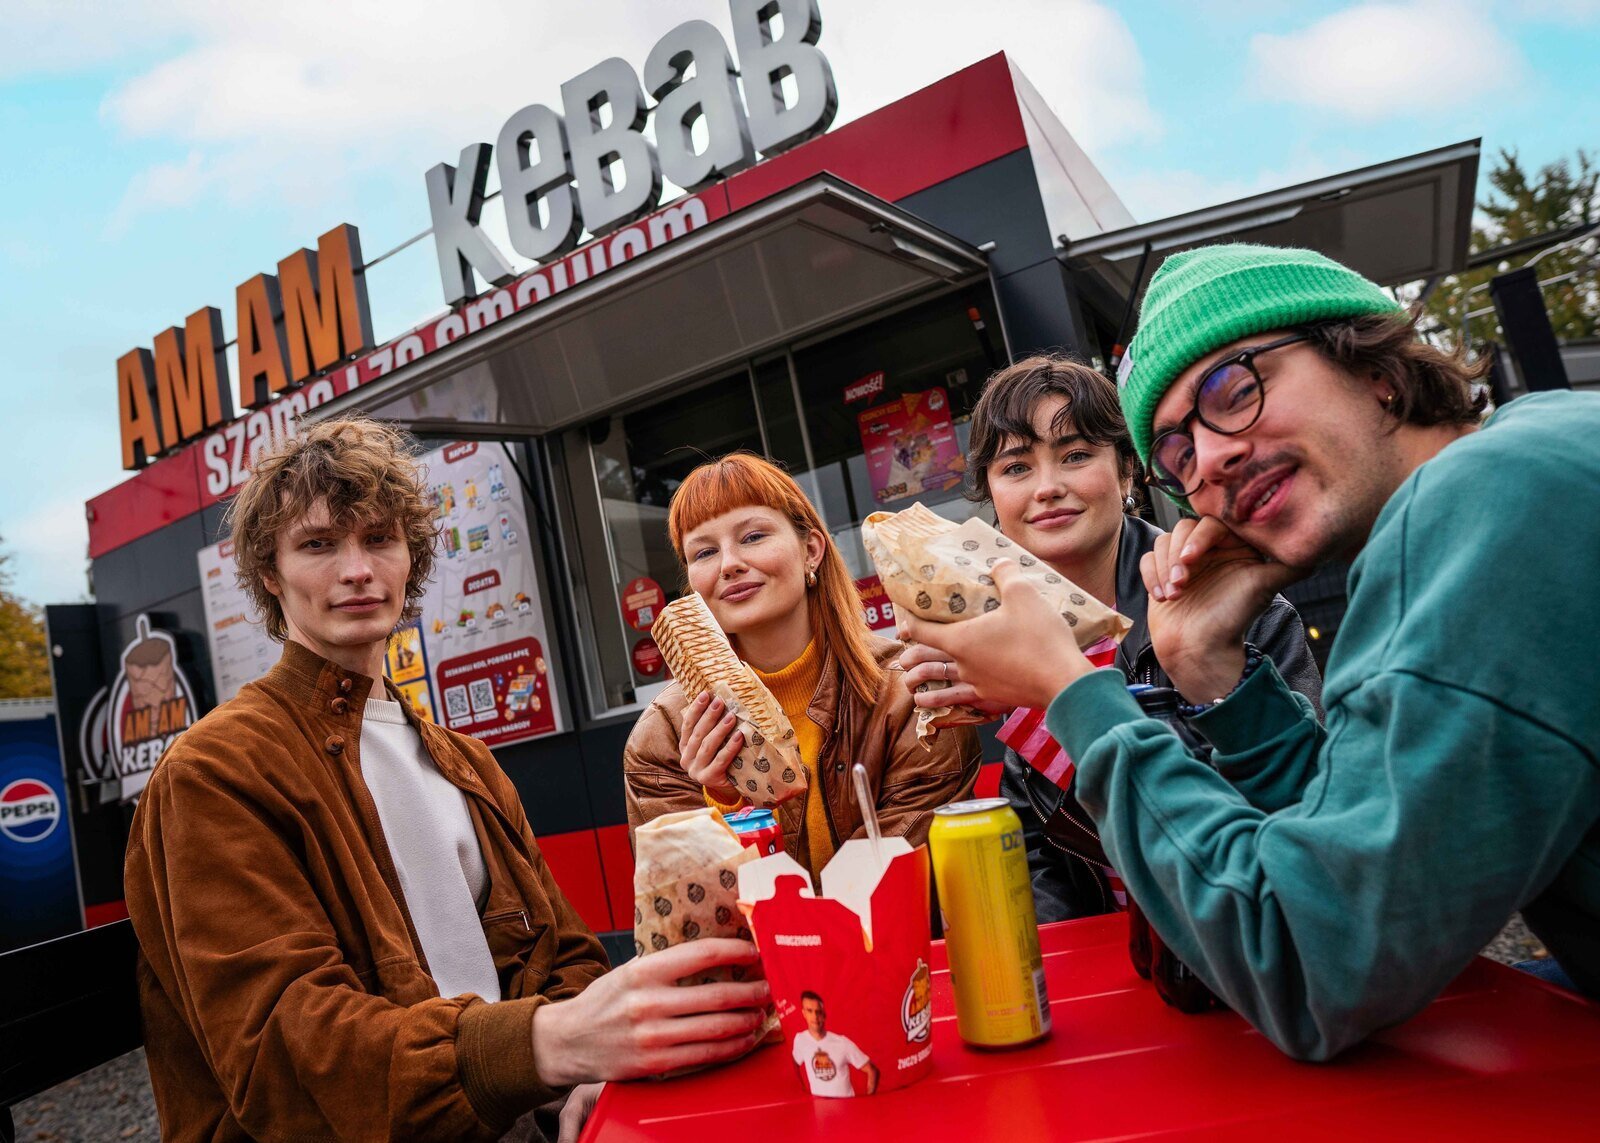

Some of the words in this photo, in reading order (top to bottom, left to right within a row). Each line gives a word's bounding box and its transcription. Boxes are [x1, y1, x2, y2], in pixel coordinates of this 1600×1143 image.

[117, 305, 233, 470] AM
[236, 222, 375, 410] AM
[845, 374, 883, 400] NOWOŚĆ!
[124, 705, 152, 744] AM
[159, 697, 187, 732] AM
[0, 801, 56, 820] PEPSI
